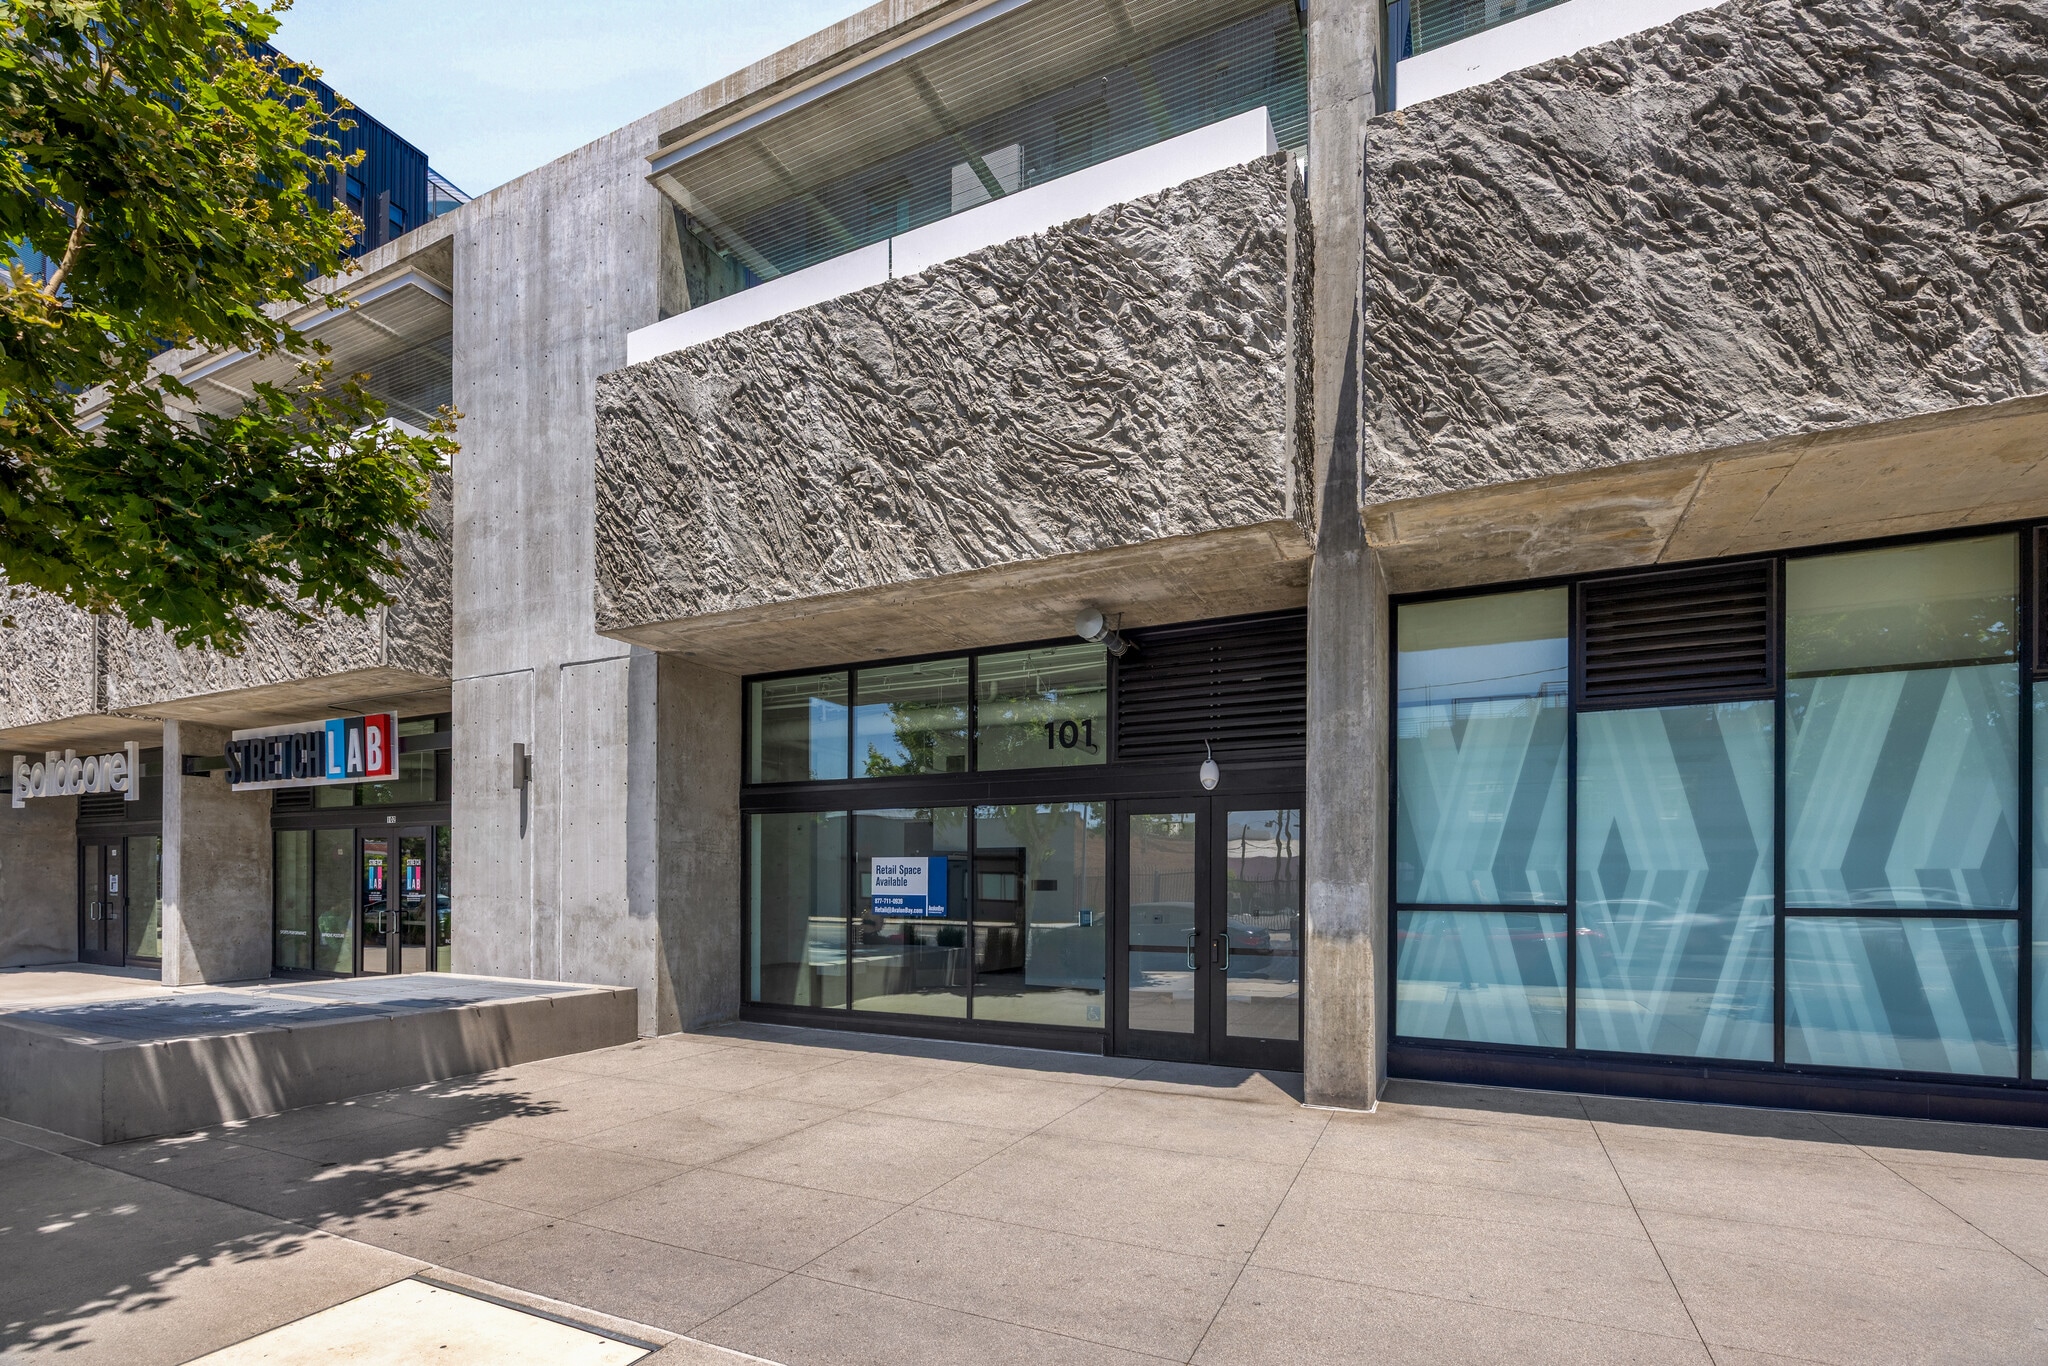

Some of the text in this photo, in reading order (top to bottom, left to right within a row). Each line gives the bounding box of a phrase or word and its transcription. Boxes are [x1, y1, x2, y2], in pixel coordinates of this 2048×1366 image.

[1045, 719, 1091, 749] 101
[876, 865, 921, 876] Retail Space
[876, 877, 907, 886] Available
